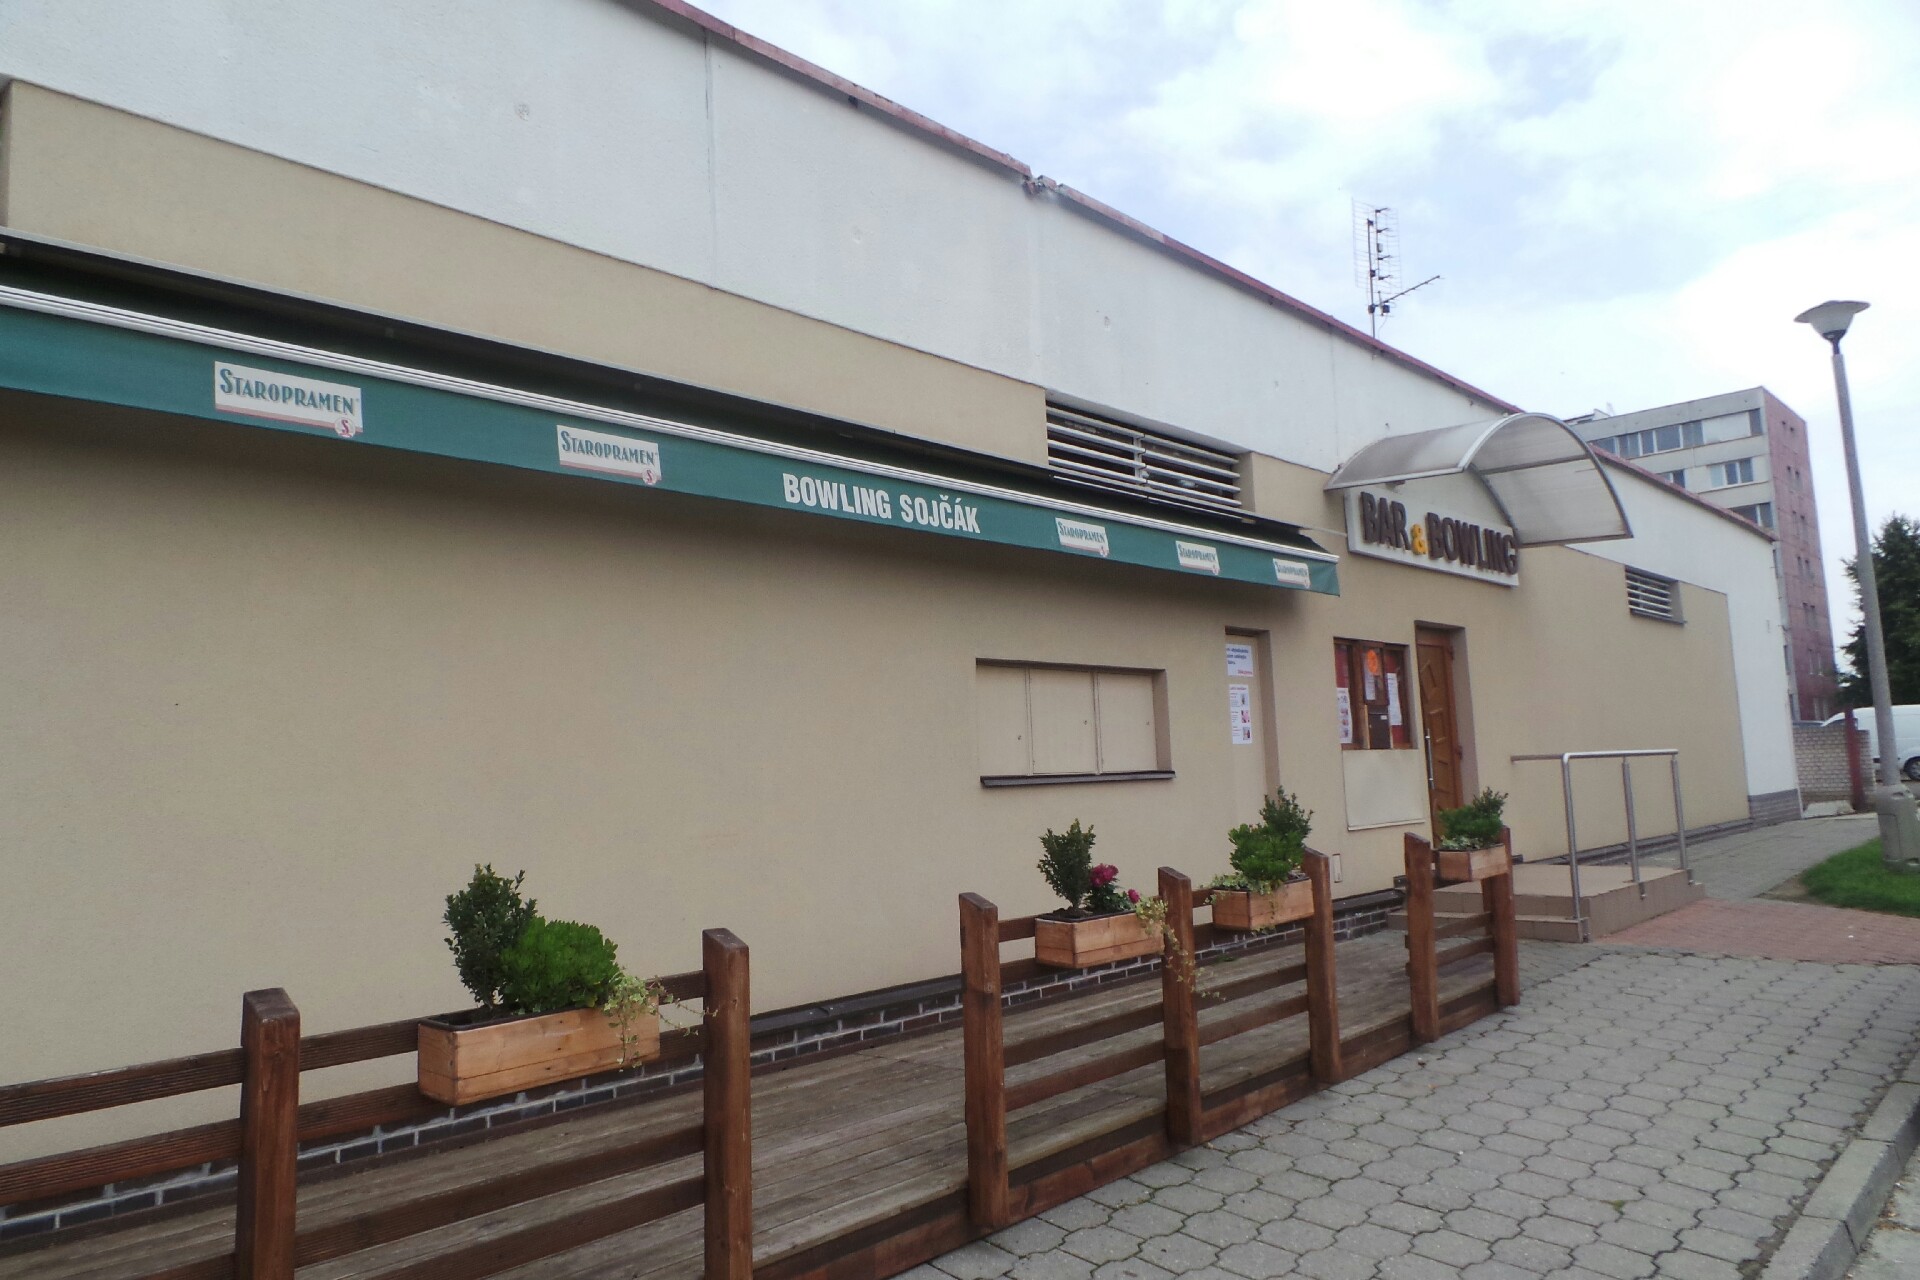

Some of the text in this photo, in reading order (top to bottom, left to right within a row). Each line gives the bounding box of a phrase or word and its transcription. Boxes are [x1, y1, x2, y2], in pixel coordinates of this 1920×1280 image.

[219, 368, 354, 415] STAROPRAMEN
[560, 430, 655, 466] STAROPRAMEN
[782, 473, 981, 534] BOWLING SOJČÁK
[1361, 491, 1519, 575] BAR & BOWLING
